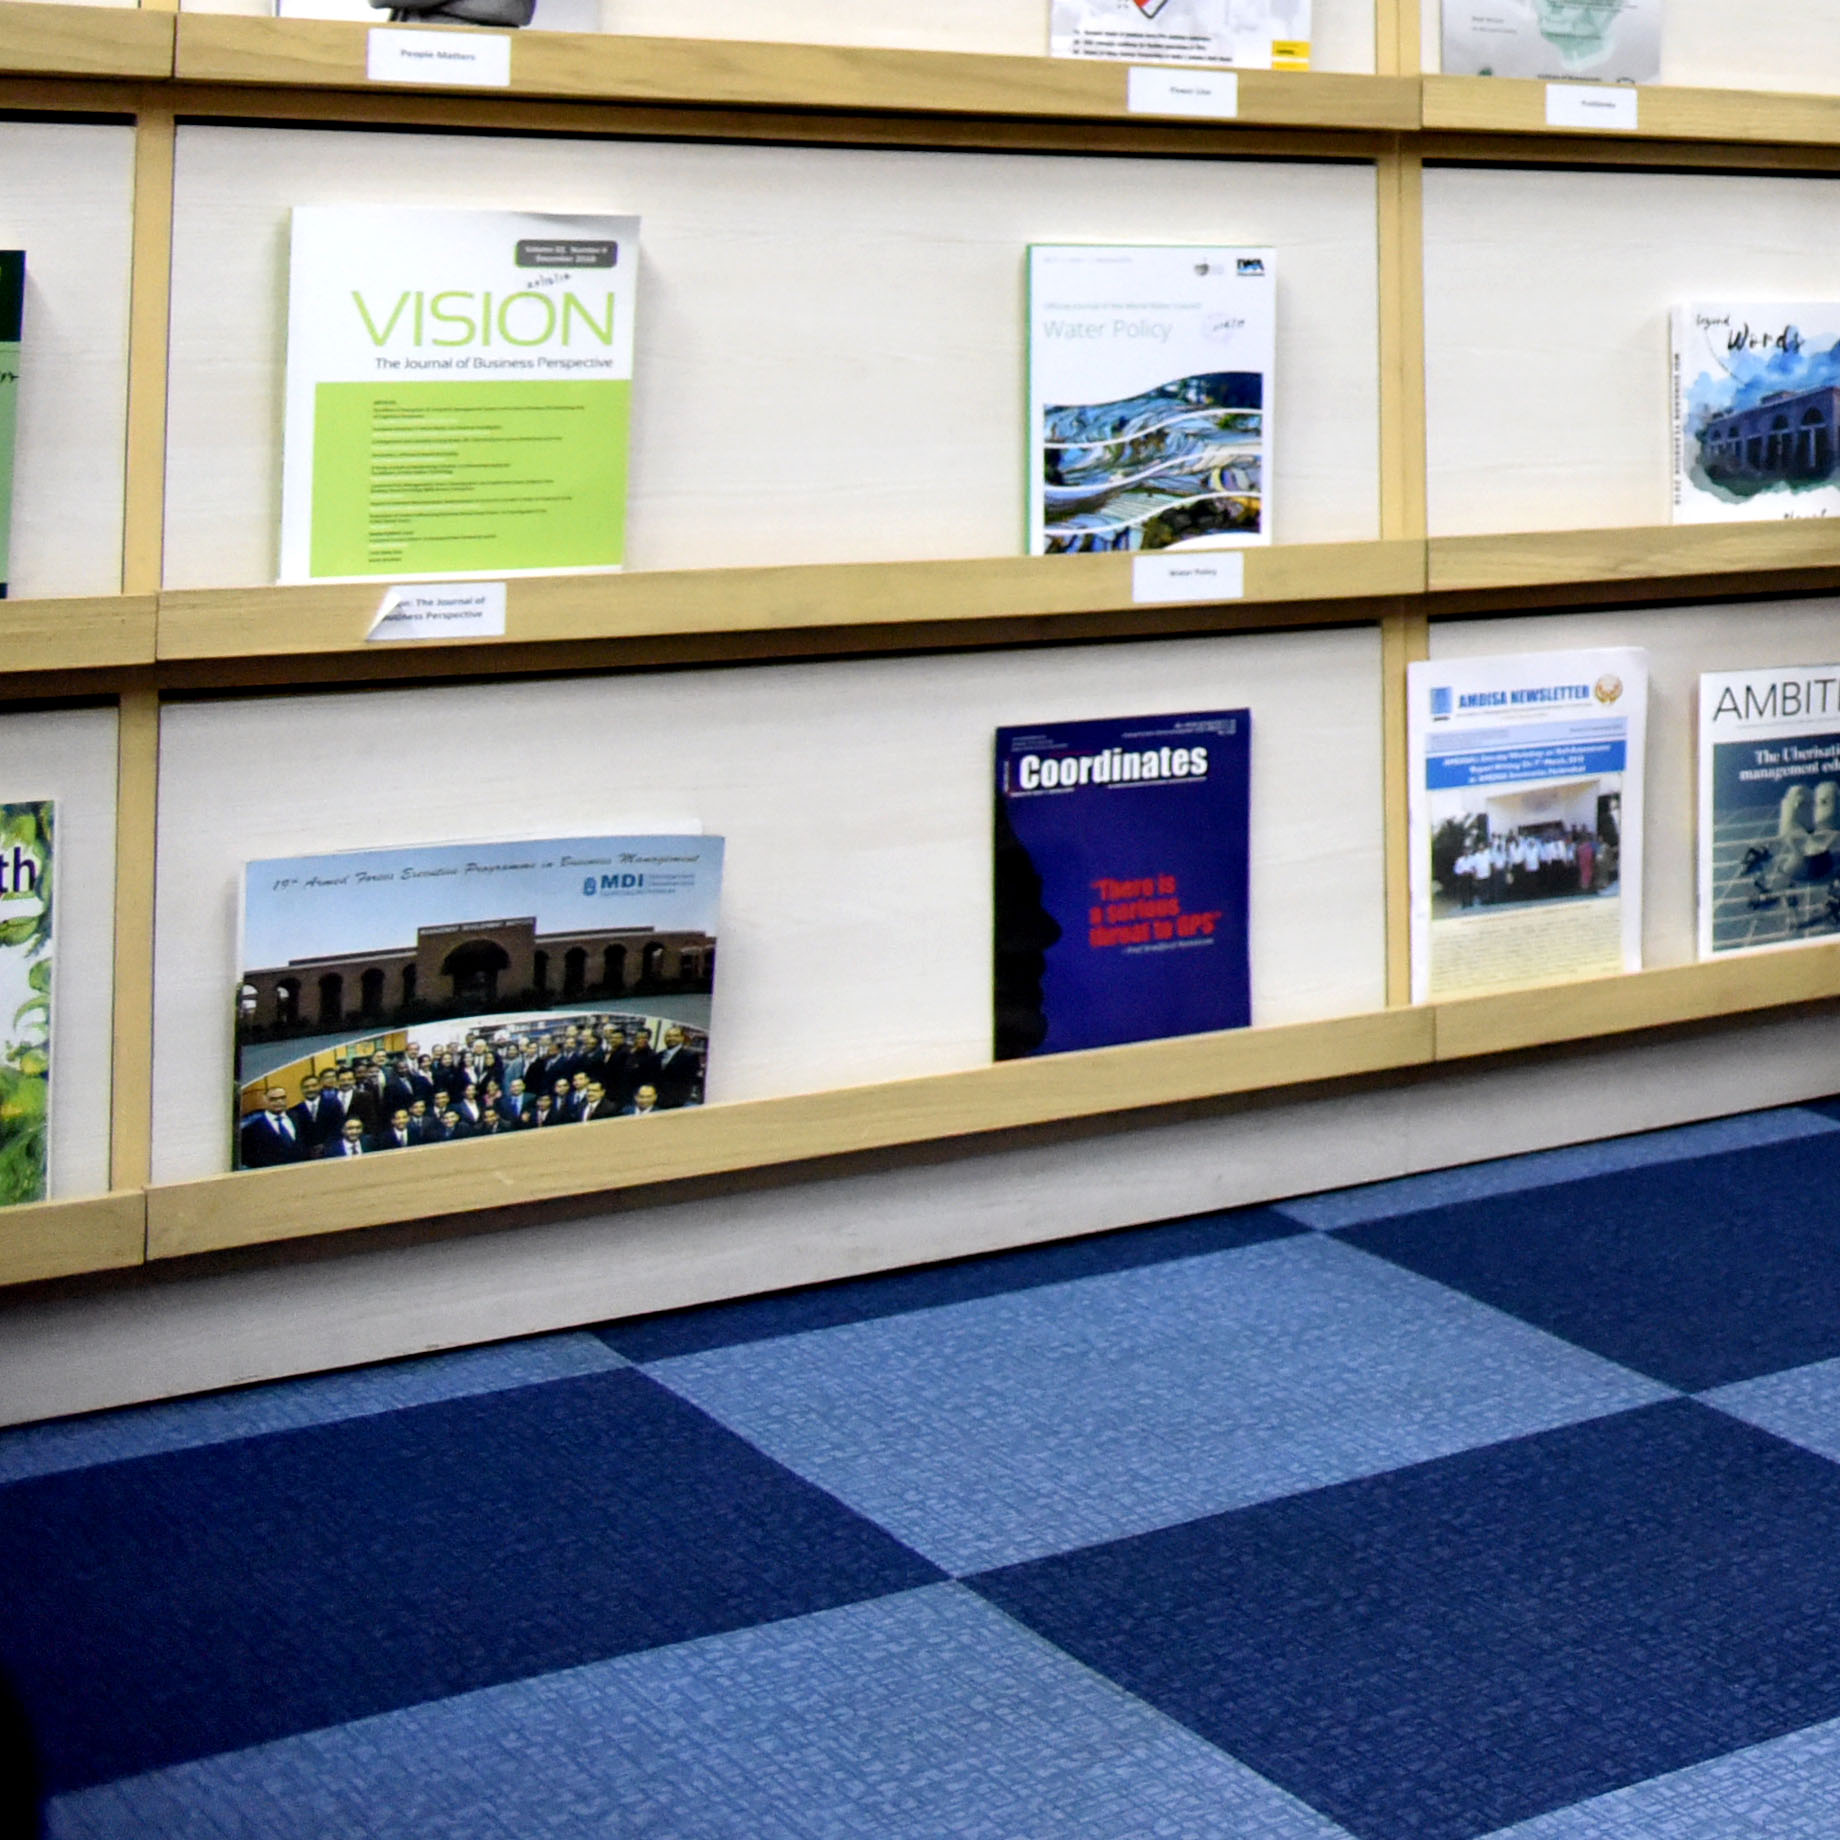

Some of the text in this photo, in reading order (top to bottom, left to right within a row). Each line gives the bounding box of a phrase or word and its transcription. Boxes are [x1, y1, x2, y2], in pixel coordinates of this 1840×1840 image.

[400, 48, 476, 62] People Matters
[351, 290, 615, 348] VISION
[1044, 320, 1173, 342] Water Policy
[376, 357, 614, 370] The Journal of Business Perspective
[1459, 685, 1590, 709] AMDISA NEWSLETTER
[1755, 749, 1780, 765] The
[1019, 747, 1208, 789] Coordinates
[1739, 761, 1819, 782] management
[600, 873, 644, 890] MDI
